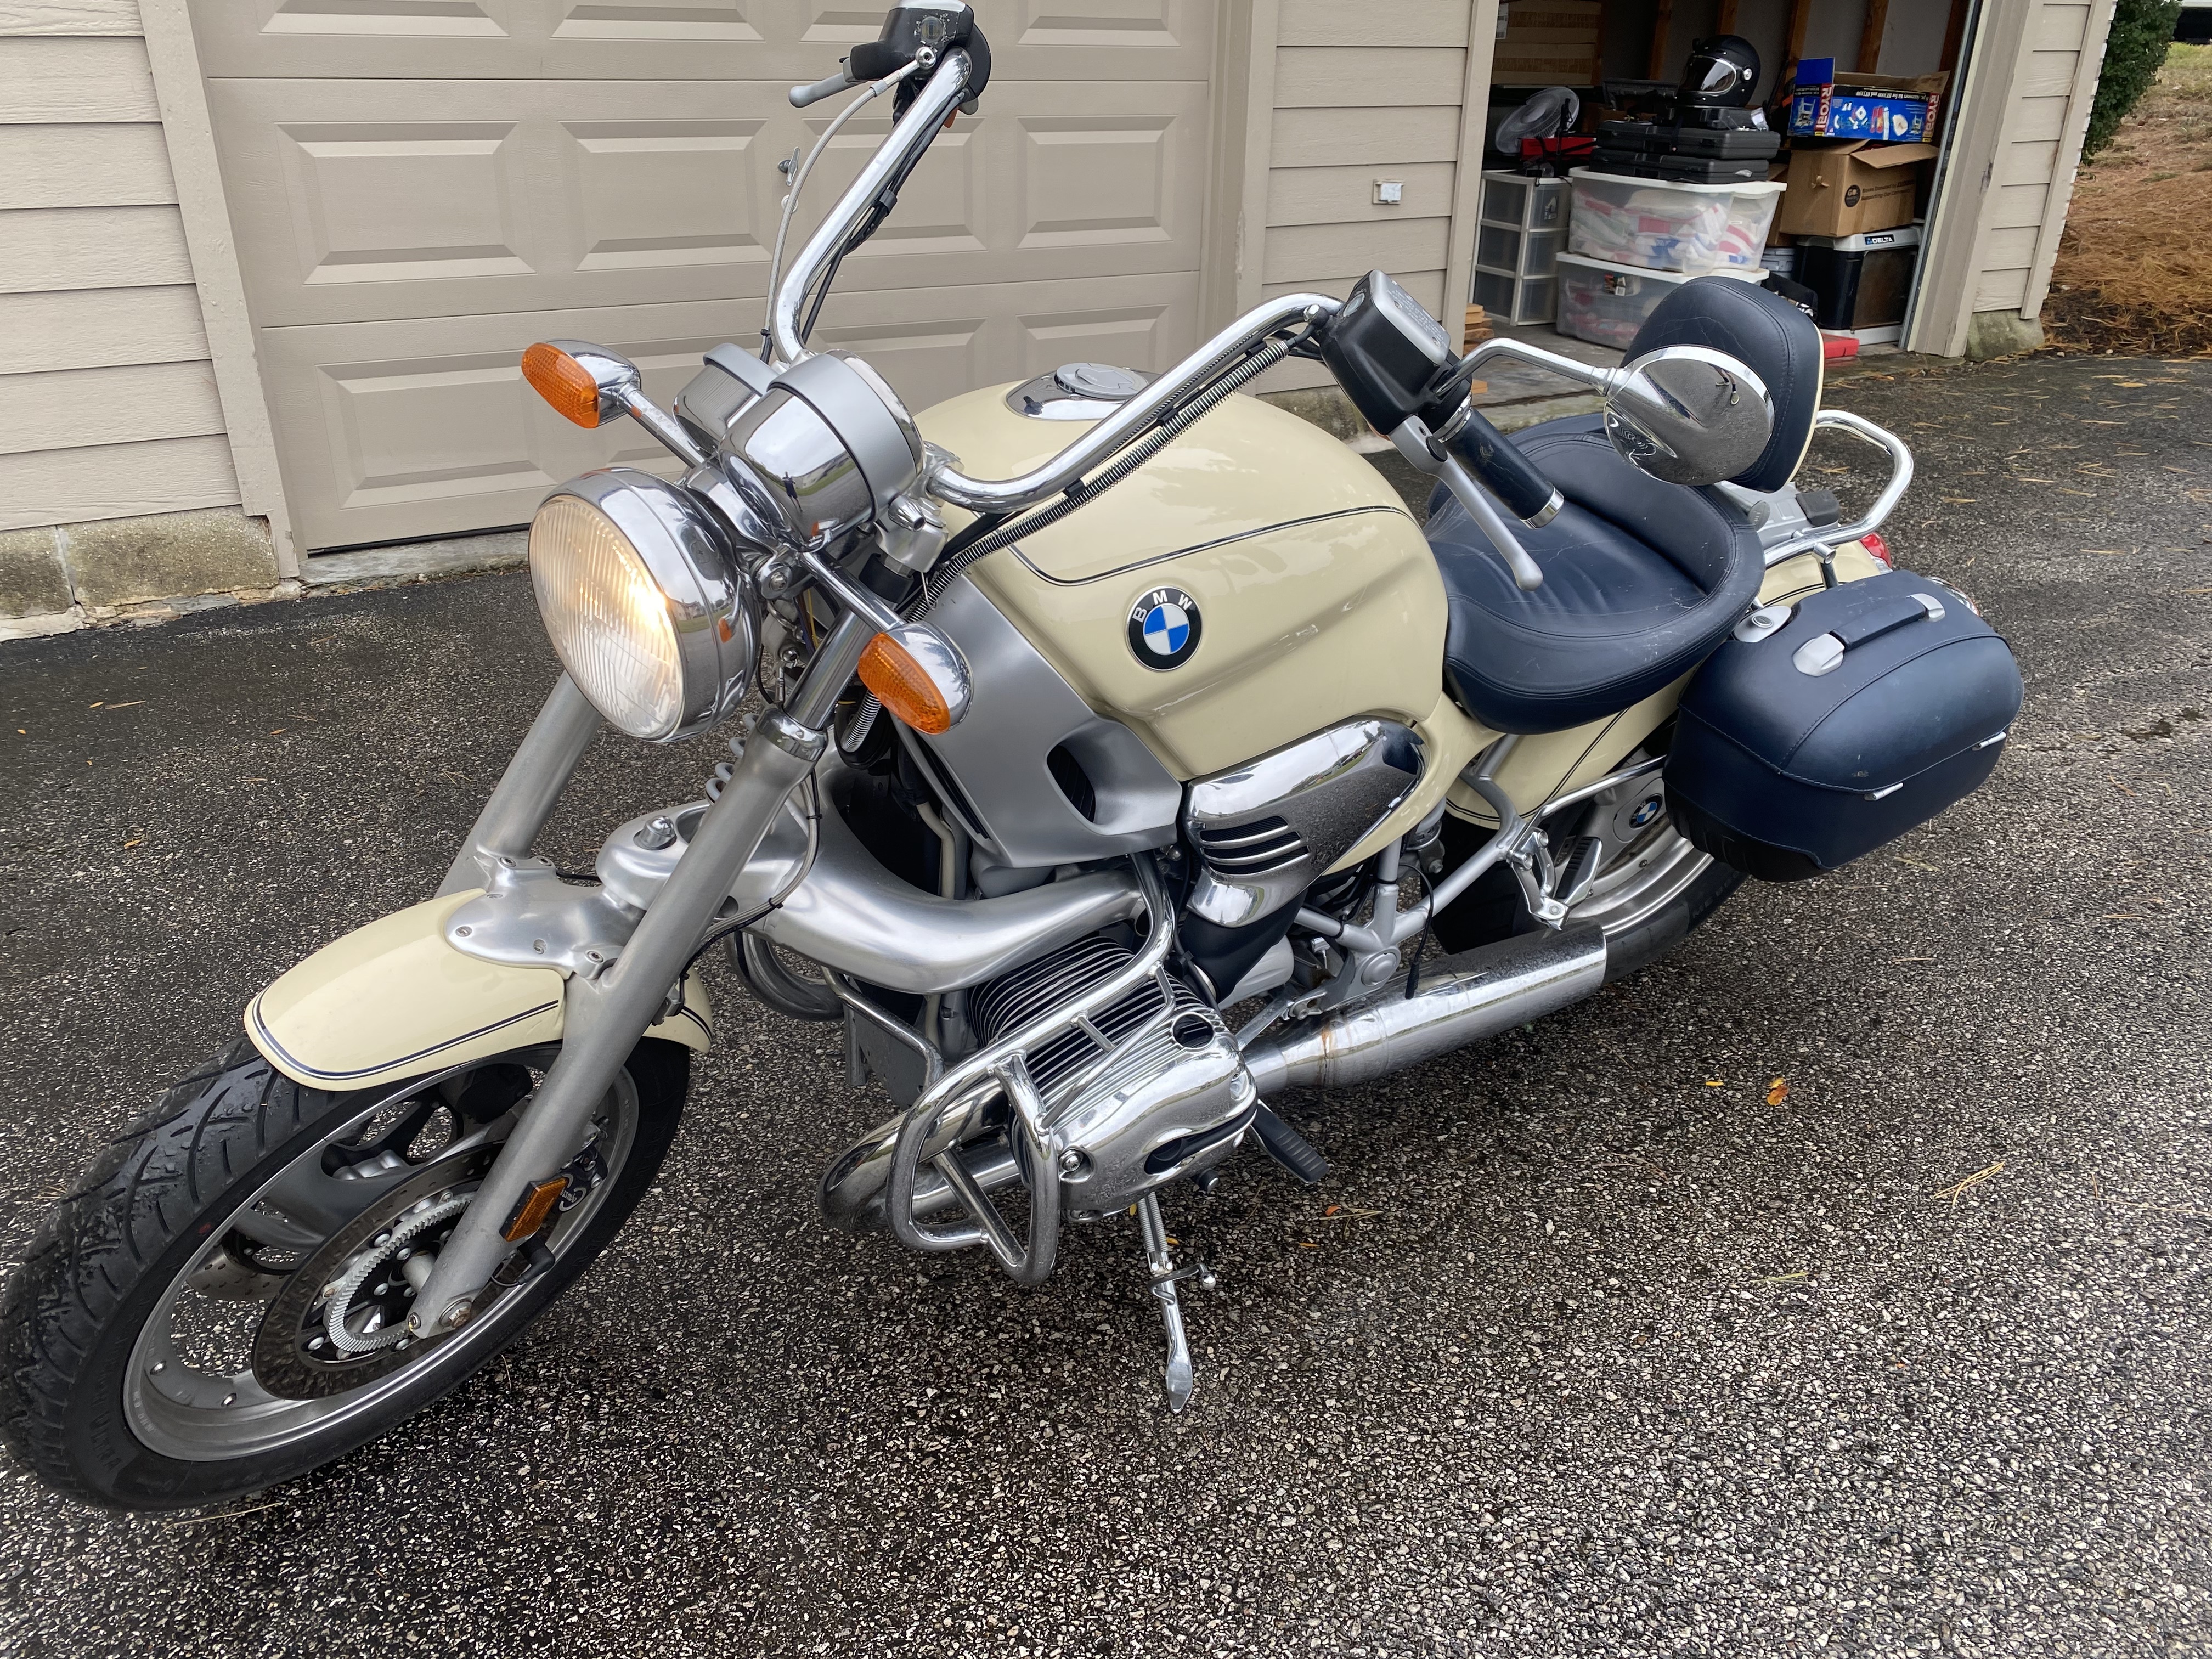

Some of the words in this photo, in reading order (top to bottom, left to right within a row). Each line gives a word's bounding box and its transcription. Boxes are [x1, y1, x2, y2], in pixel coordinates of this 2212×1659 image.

[1815, 87, 1832, 128] RYOBI
[1132, 590, 1192, 623] BMW
[1632, 800, 1646, 827] BMW
